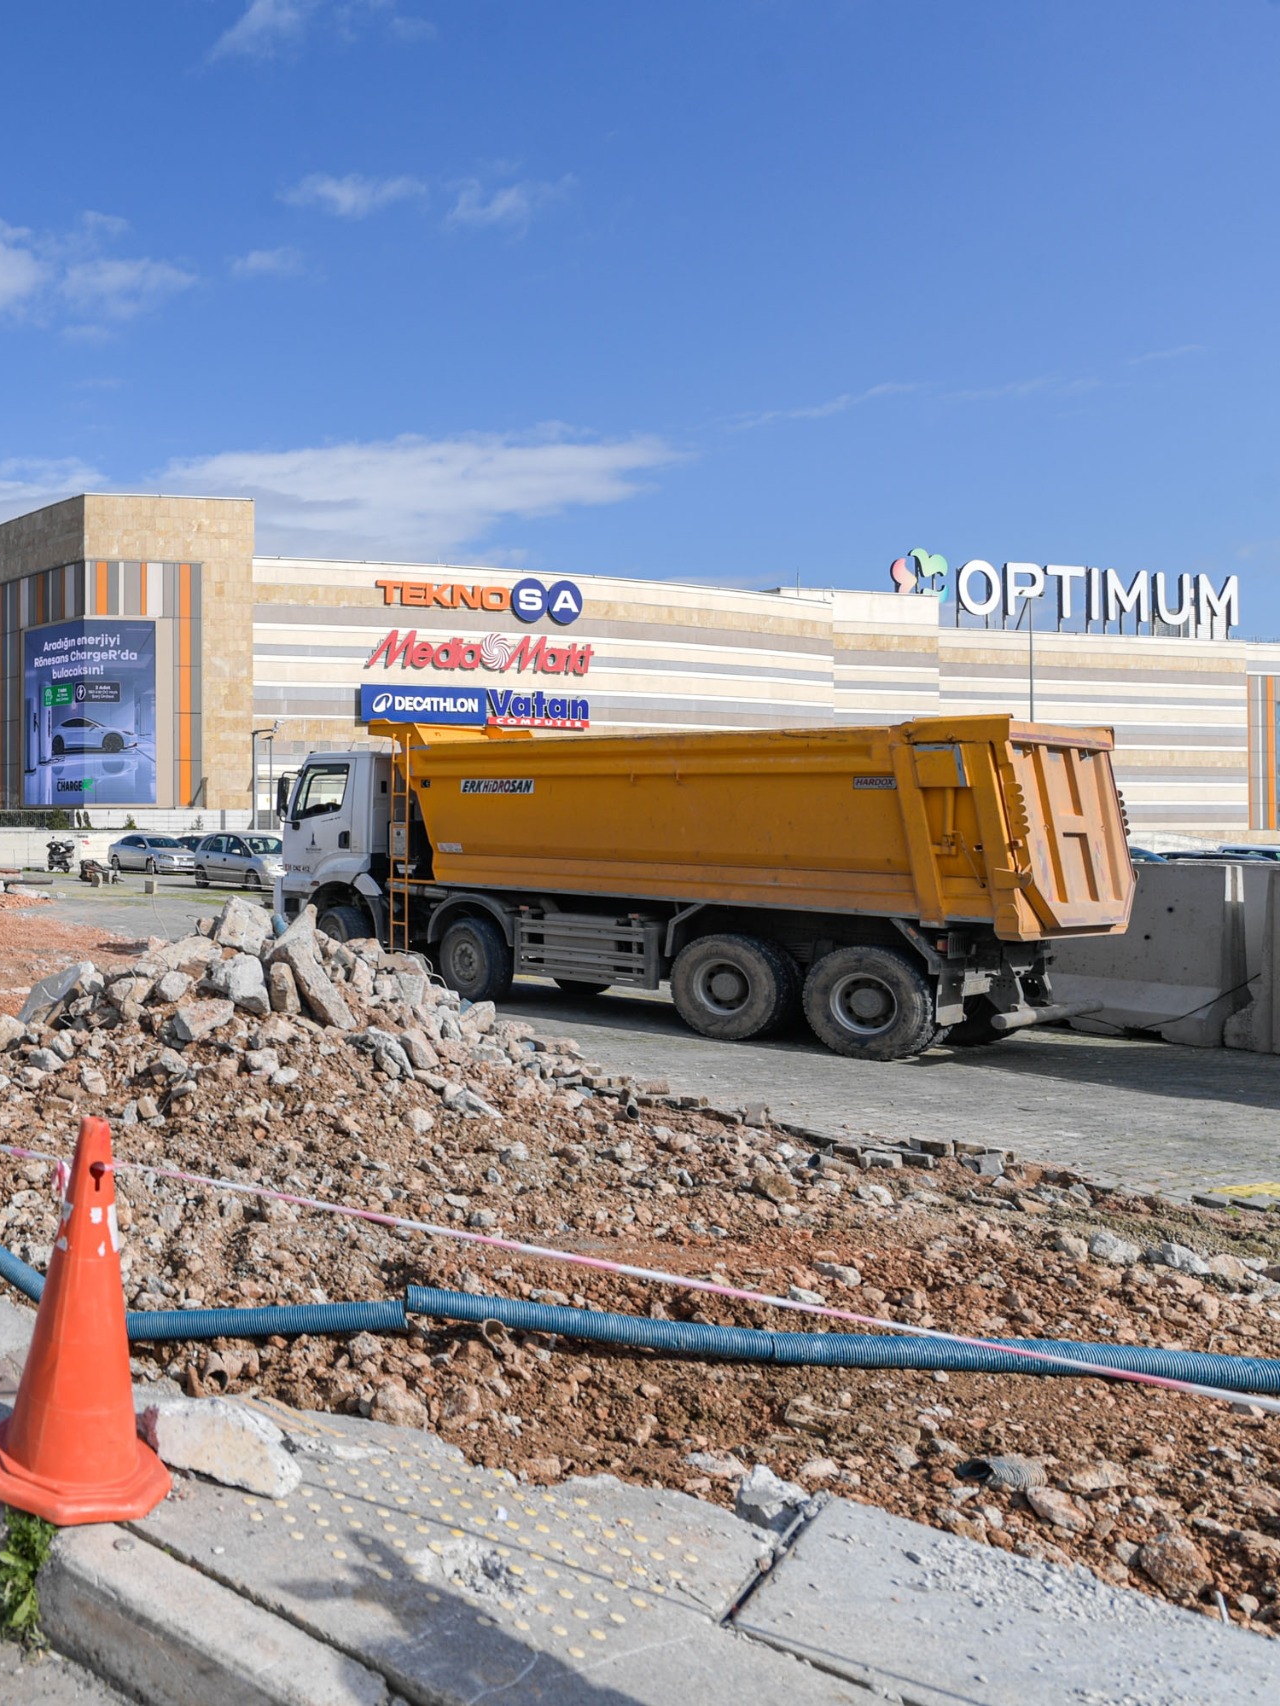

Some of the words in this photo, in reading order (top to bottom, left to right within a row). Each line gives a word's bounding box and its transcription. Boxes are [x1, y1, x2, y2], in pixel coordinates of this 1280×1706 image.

[376, 579, 581, 615] TEKNOSA
[957, 559, 1240, 627] OPTIMUM
[43, 638, 76, 652] Aradığın
[77, 633, 121, 647] enerjiyi
[34, 655, 69, 668] Rönesans
[52, 665, 104, 680] bulacaksın!
[394, 695, 479, 713] DECATHLON
[488, 689, 590, 721] Vatan
[496, 717, 583, 729] COMPUTER
[855, 778, 893, 786] HARDOX
